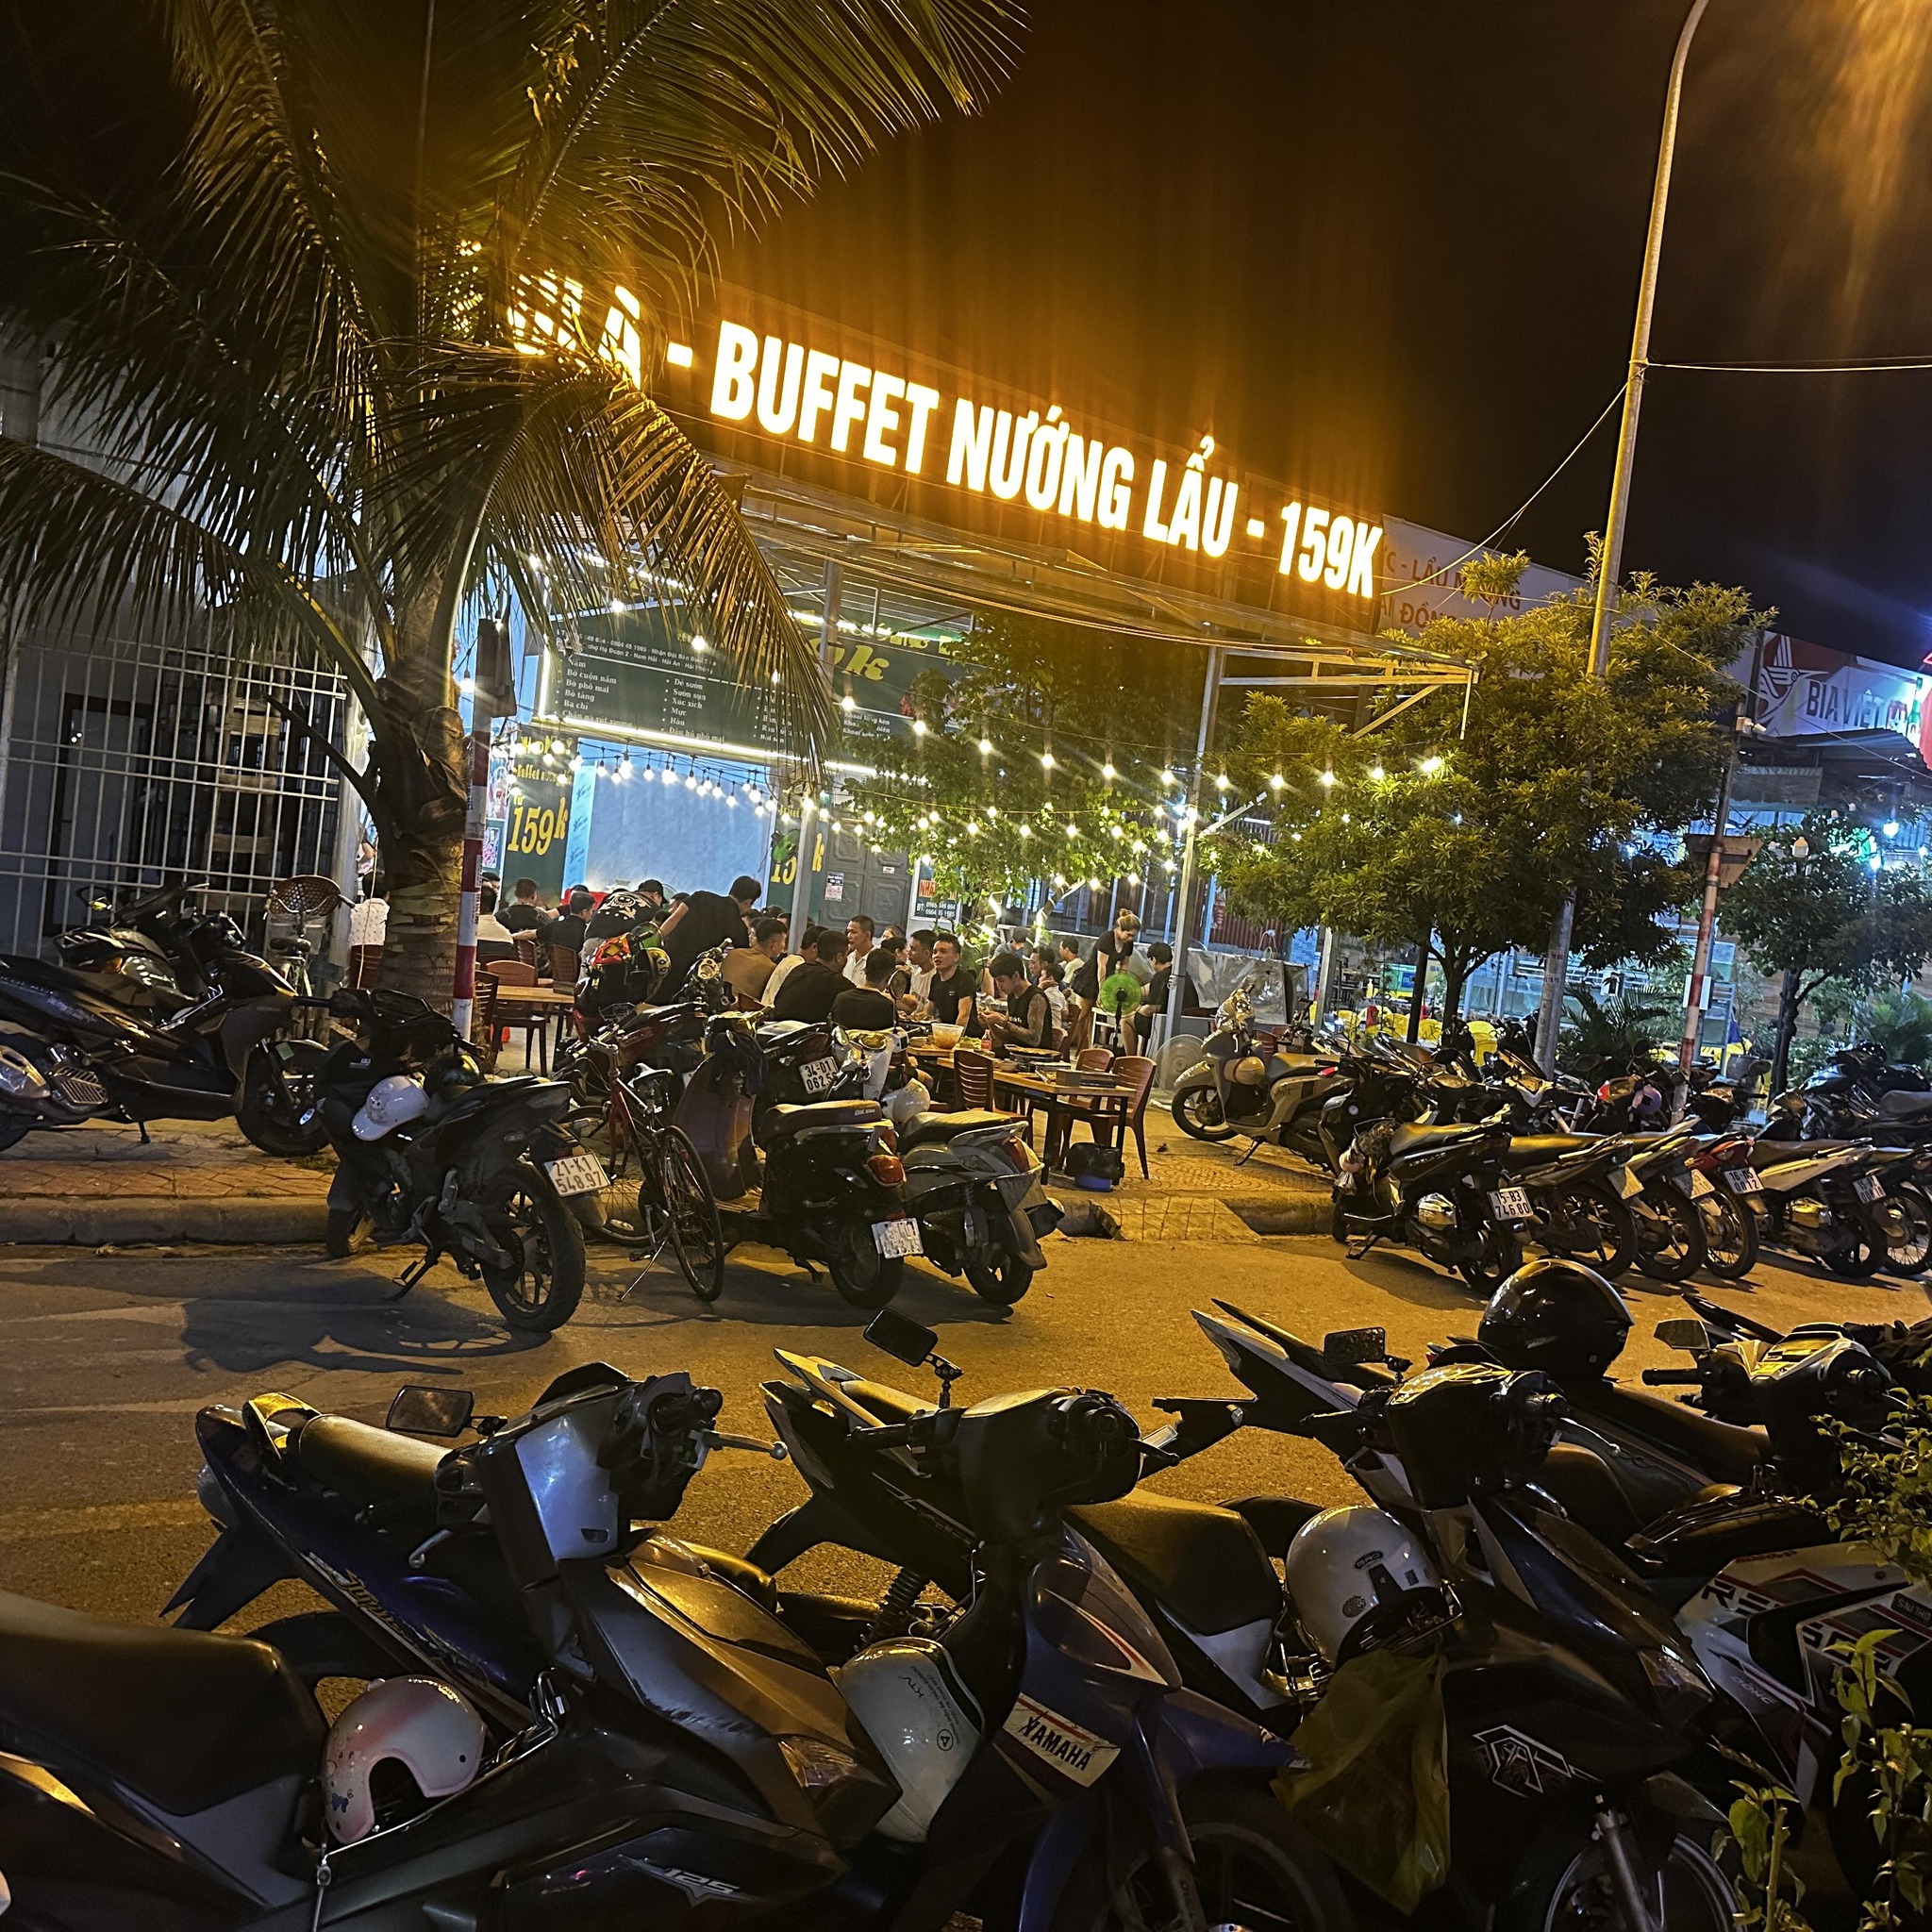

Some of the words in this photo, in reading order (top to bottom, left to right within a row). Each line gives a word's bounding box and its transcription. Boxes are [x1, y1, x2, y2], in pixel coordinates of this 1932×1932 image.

[709, 322, 940, 474] BUFFET
[946, 398, 1135, 530] NƯỚNG
[1142, 435, 1239, 557] LẨU
[1279, 502, 1384, 598] 159K
[595, 685, 609, 694] mai
[1807, 680, 1840, 724] BIA
[507, 797, 569, 856] 159k
[805, 1060, 832, 1077] 34-01
[552, 1157, 592, 1177] 21-K1
[555, 1171, 603, 1193] 548.97
[1494, 1202, 1530, 1218] 746.80
[902, 1676, 924, 1698] KTV
[1018, 1716, 1092, 1773] YAMAHA
[663, 1867, 741, 1894] 125
